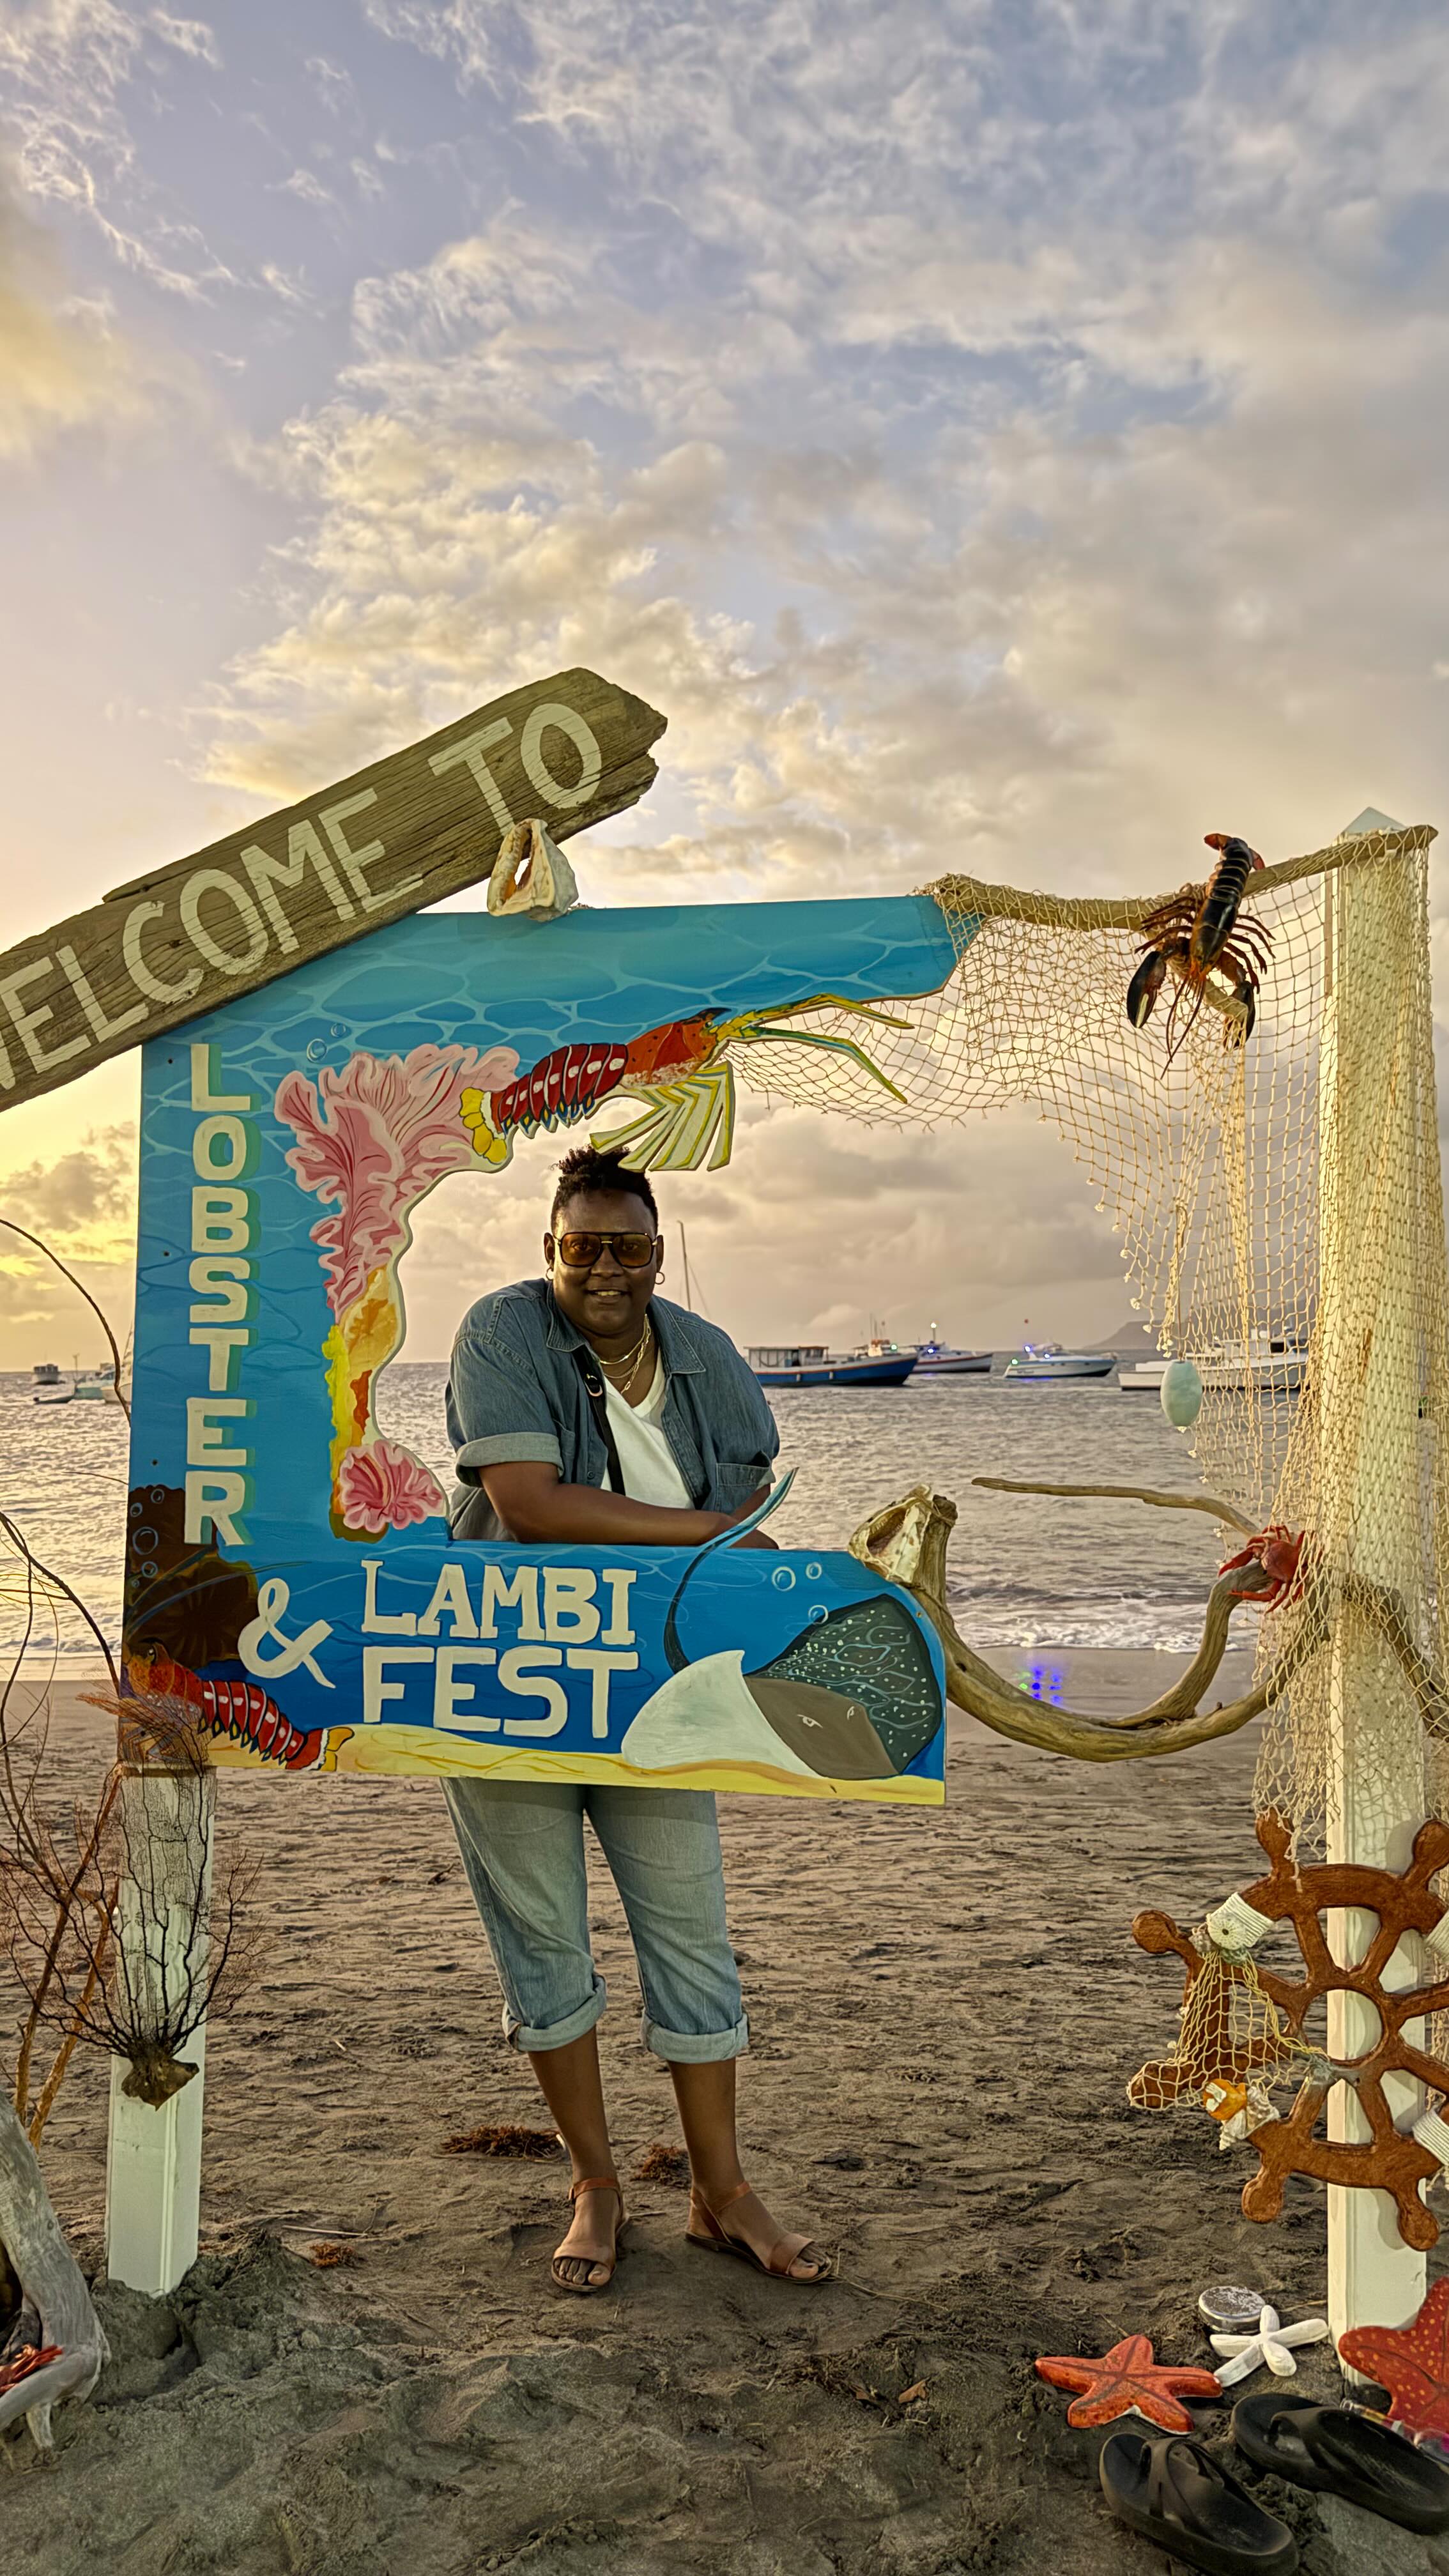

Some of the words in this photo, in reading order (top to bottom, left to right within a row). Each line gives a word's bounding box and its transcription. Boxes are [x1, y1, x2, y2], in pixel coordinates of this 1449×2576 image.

[0, 788, 424, 1090] ELCOME
[427, 703, 602, 838] TO
[184, 1043, 253, 1546] LOBSTER
[238, 1578, 335, 1689] &
[361, 1560, 637, 1645] LAMBI
[363, 1646, 638, 1739] FEST
